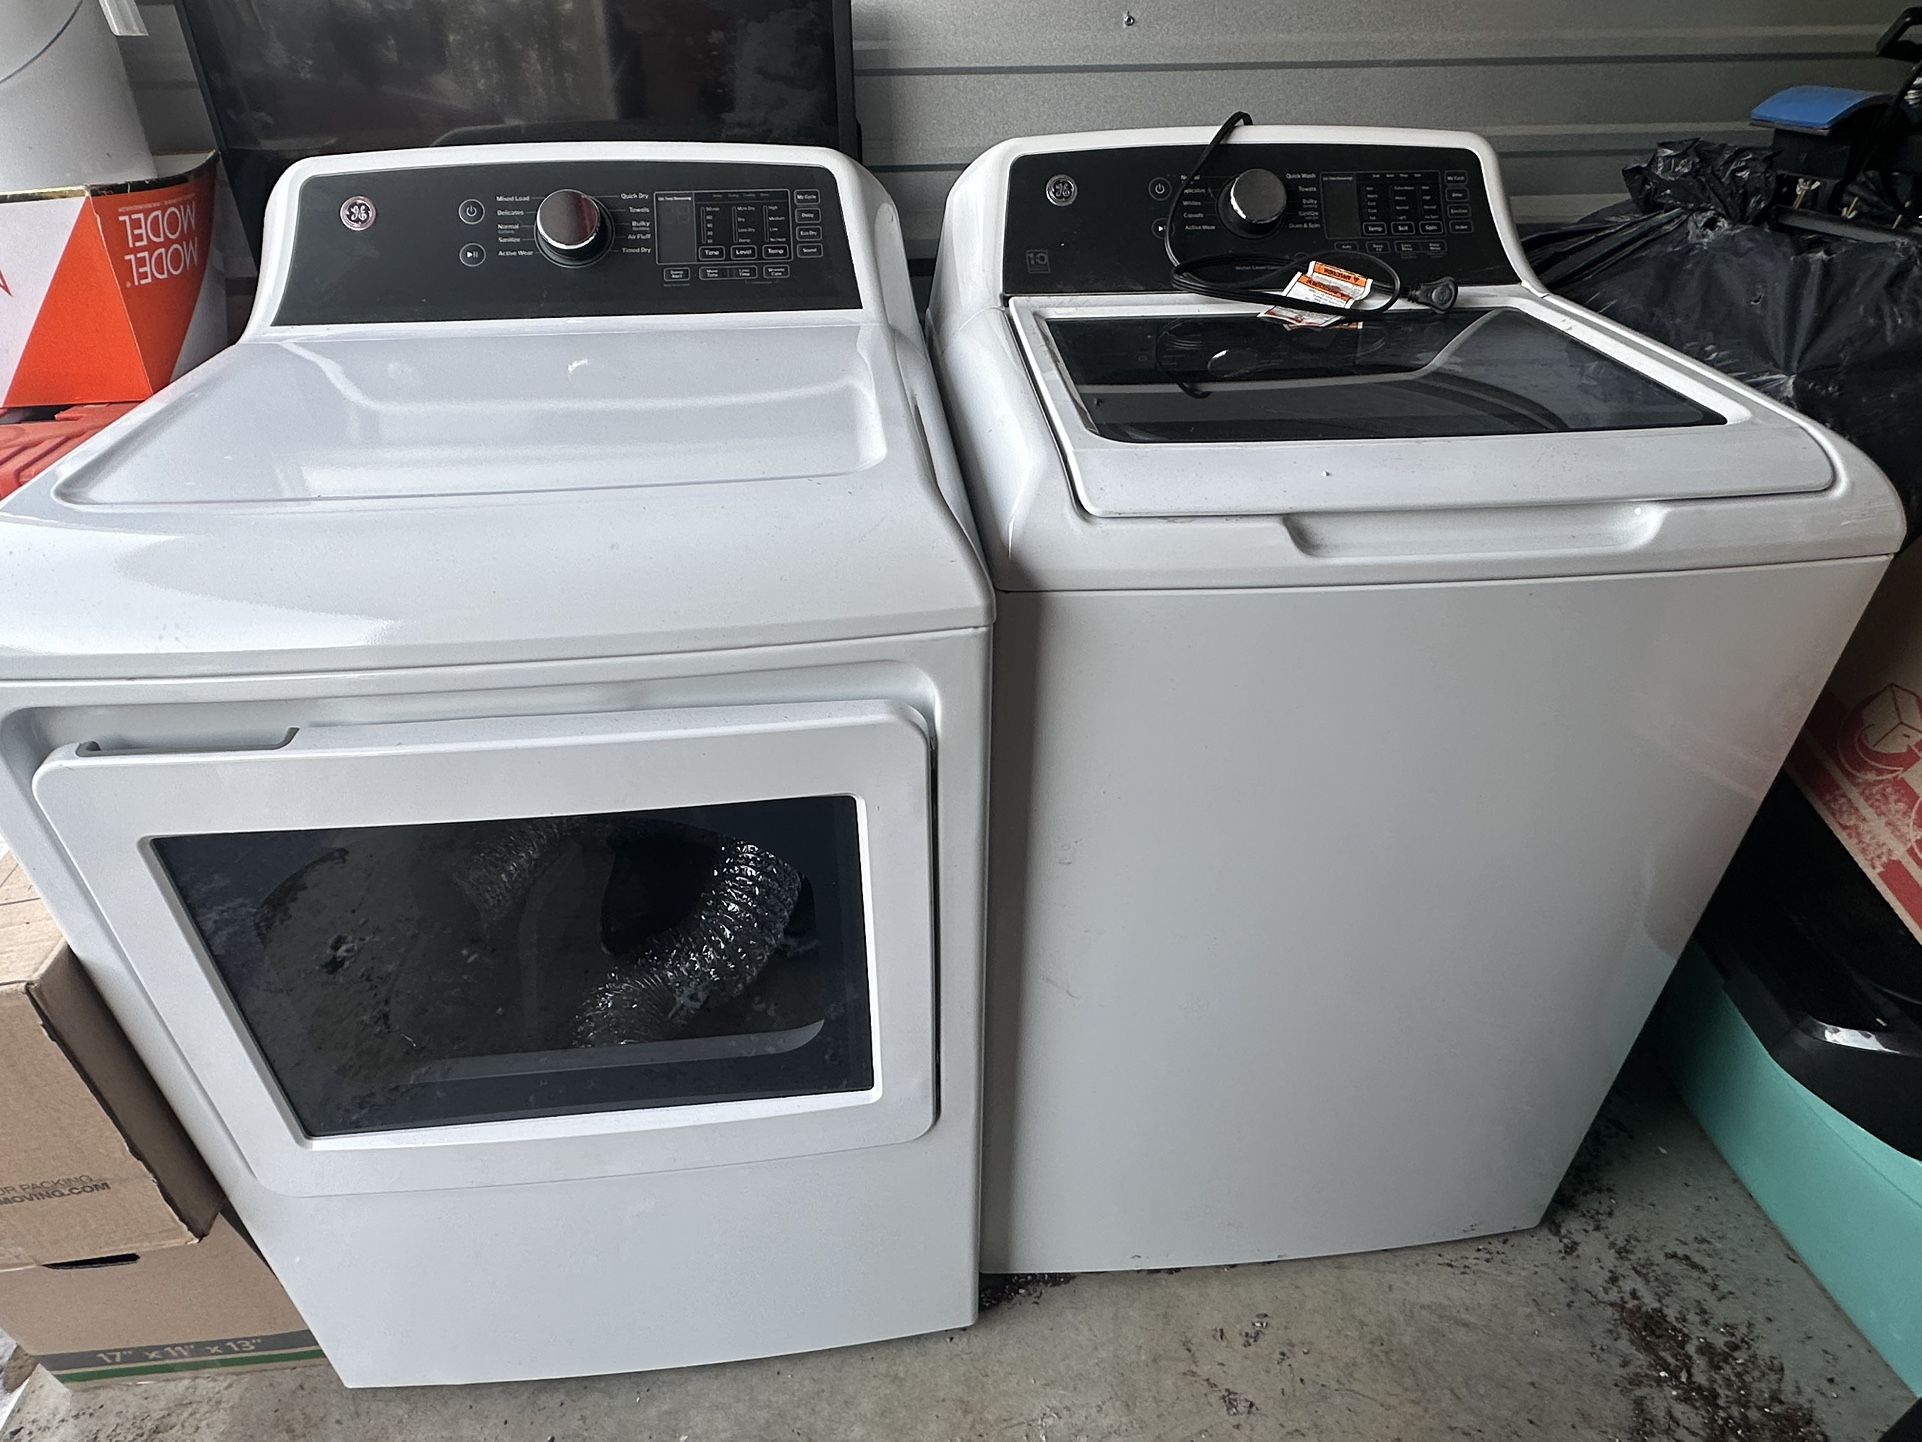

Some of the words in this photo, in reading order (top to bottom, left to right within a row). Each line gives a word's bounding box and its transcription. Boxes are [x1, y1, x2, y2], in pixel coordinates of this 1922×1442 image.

[118, 200, 196, 248] MODEL
[124, 236, 198, 286] MODEL
[96, 1350, 132, 1364] 17"
[144, 1350, 162, 1359] x
[205, 1345, 223, 1354] x
[226, 1338, 262, 1352] 13"
